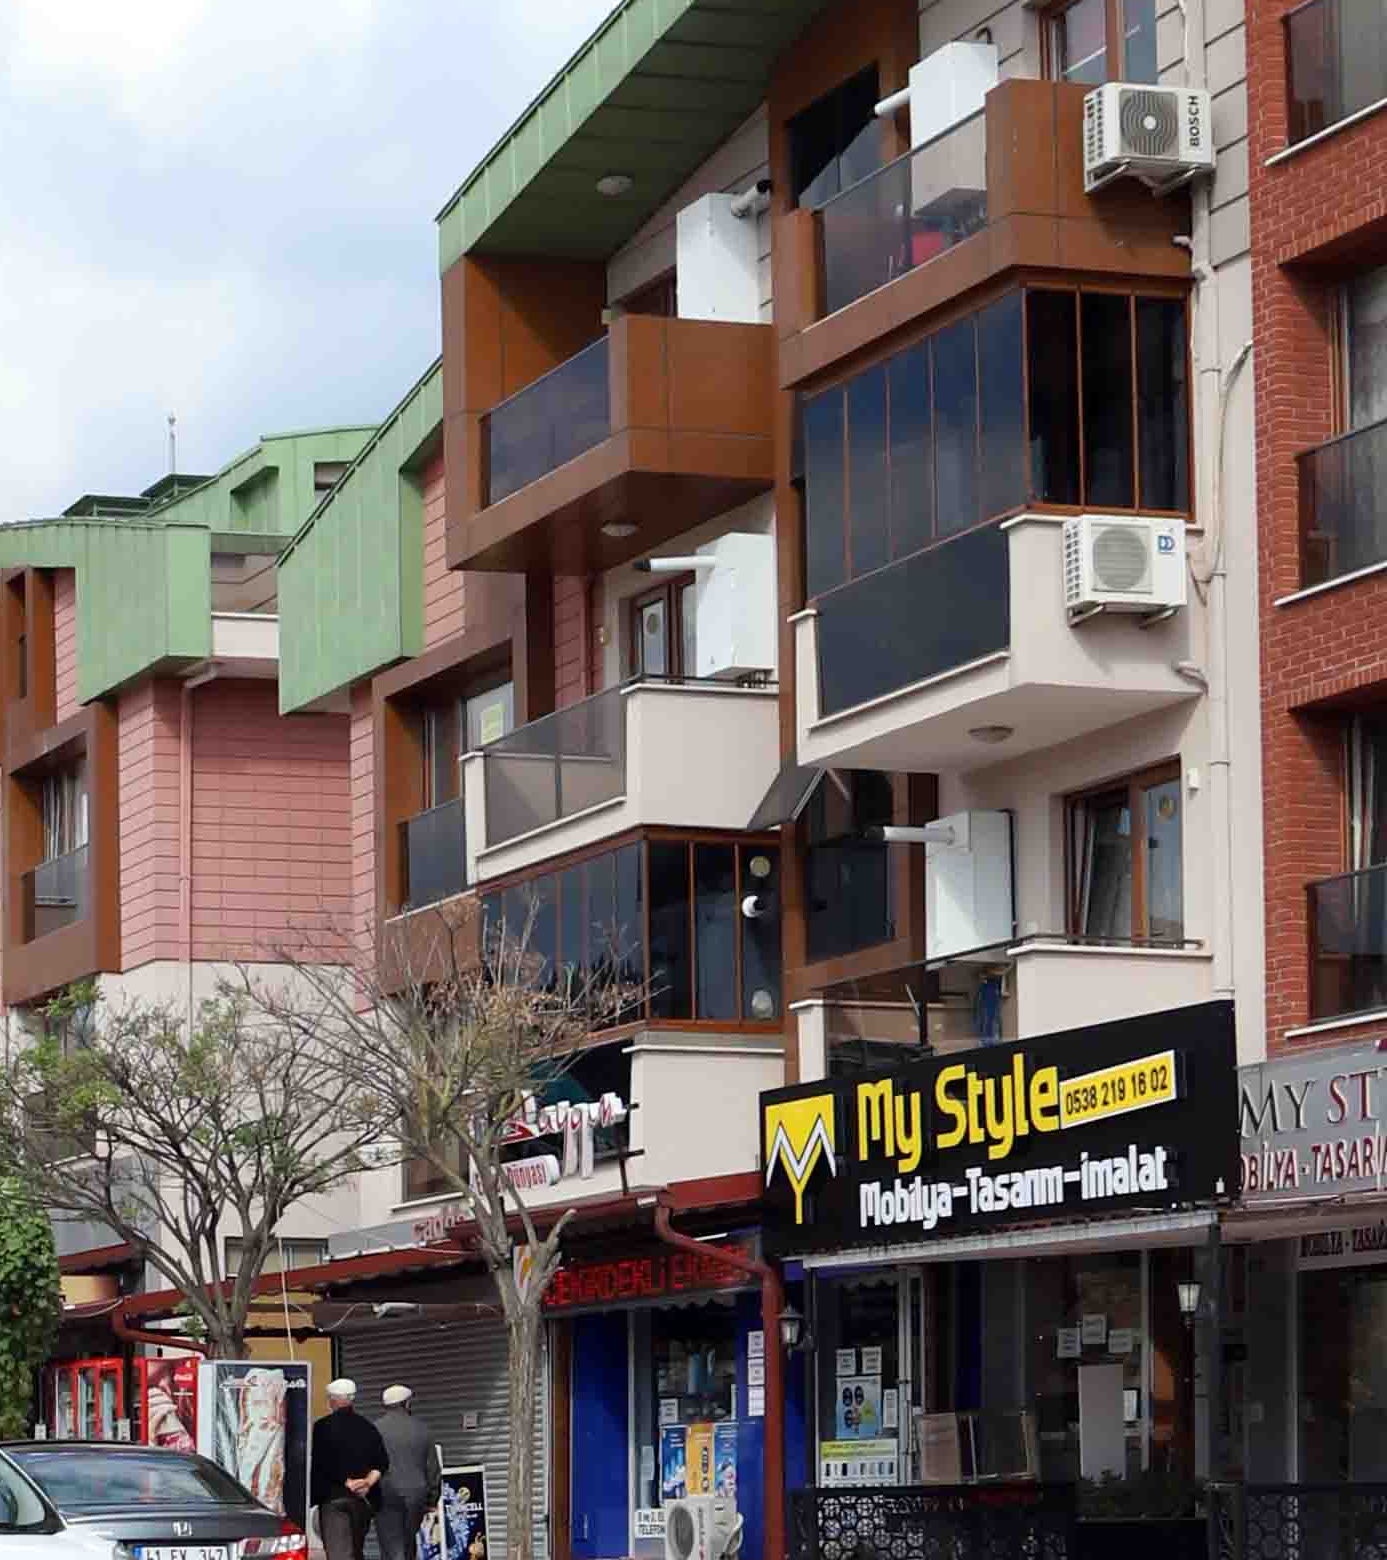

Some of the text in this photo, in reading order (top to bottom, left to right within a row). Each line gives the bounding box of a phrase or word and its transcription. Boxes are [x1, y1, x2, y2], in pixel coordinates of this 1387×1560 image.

[1188, 95, 1199, 147] BOSCH
[857, 1053, 1060, 1173] My Style
[1066, 1085, 1097, 1115] 0538
[1101, 1077, 1125, 1106] 219
[1151, 1065, 1168, 1092] 02
[1240, 1067, 1387, 1138] MY ST
